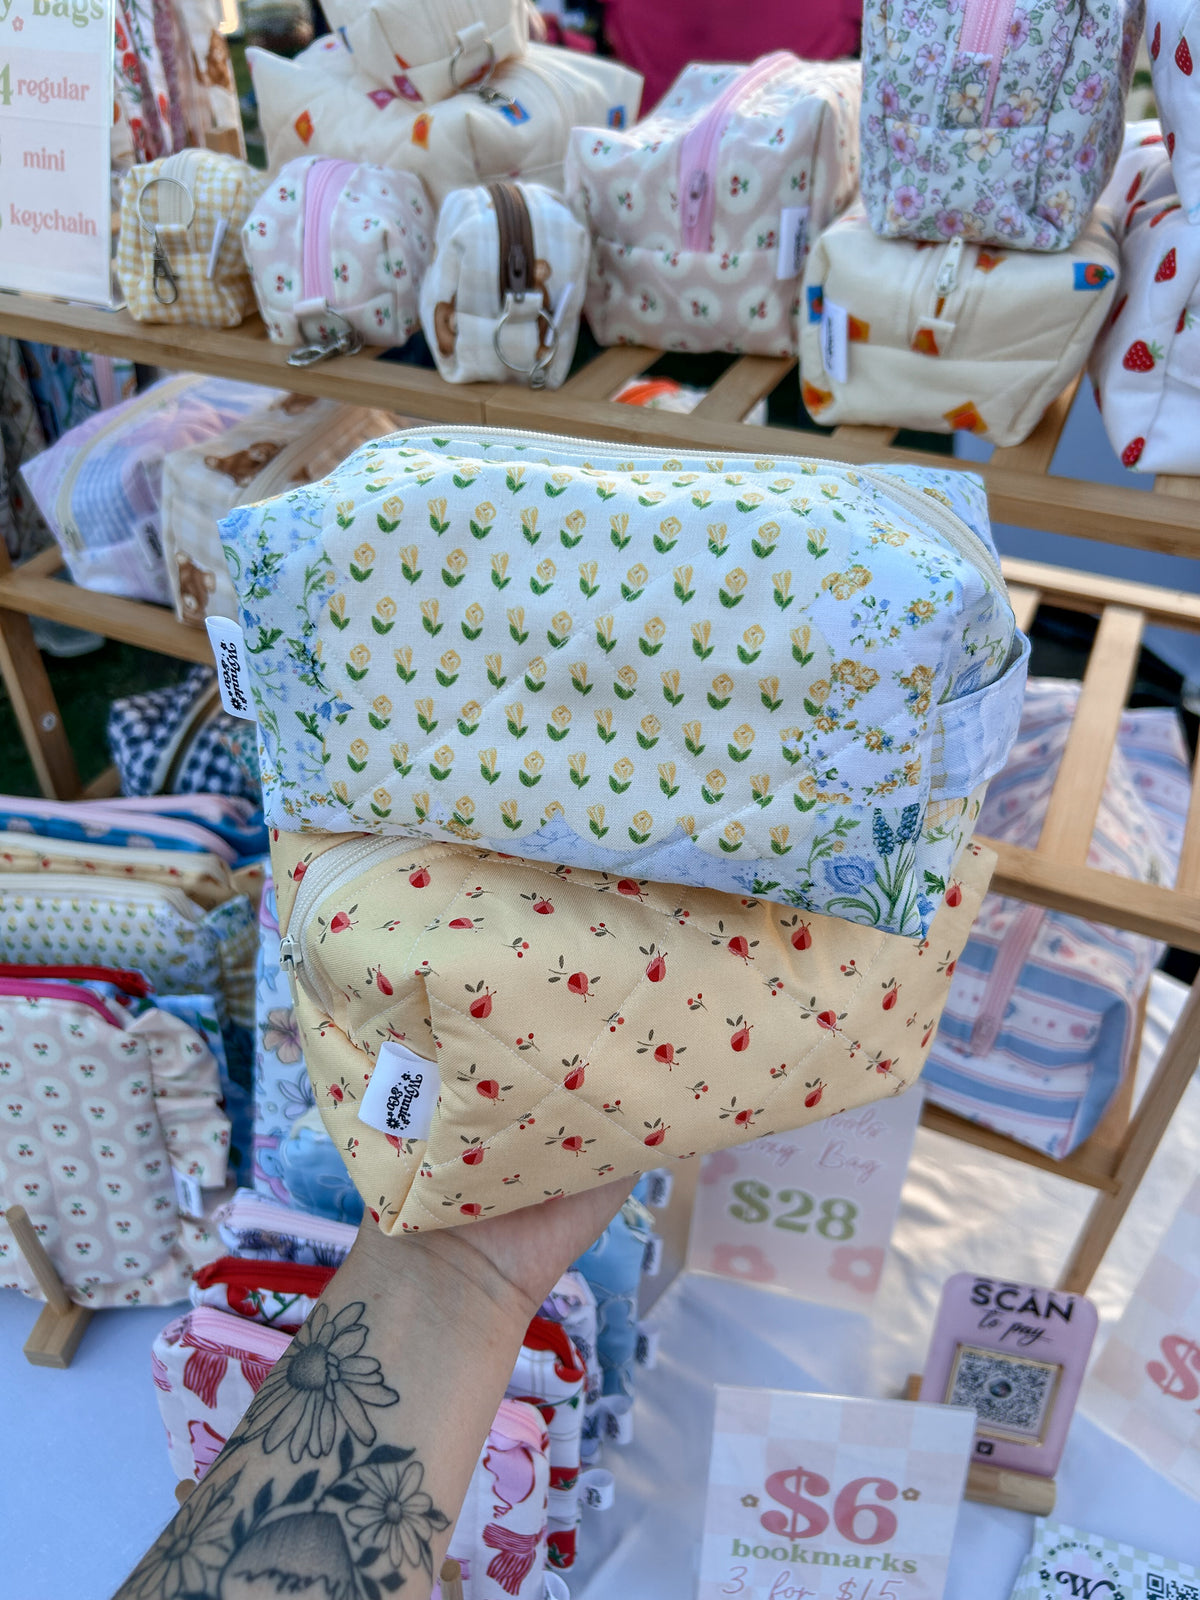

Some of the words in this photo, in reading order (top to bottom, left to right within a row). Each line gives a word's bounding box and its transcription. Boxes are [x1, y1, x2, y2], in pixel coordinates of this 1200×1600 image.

[32, 0, 105, 28] bags
[17, 77, 90, 104] regular
[23, 147, 66, 172] mini
[9, 203, 97, 237] keychain
[398, 1073, 423, 1122] Wynnie
[729, 1179, 859, 1241] $28
[970, 1279, 1075, 1323] SCAN
[978, 1309, 1001, 1330] to
[999, 1322, 1053, 1347] pay
[760, 1466, 899, 1546] $6
[731, 1538, 918, 1574] bookmarks
[722, 1566, 749, 1594] 3
[768, 1570, 816, 1600] for
[836, 1577, 904, 1600] $15
